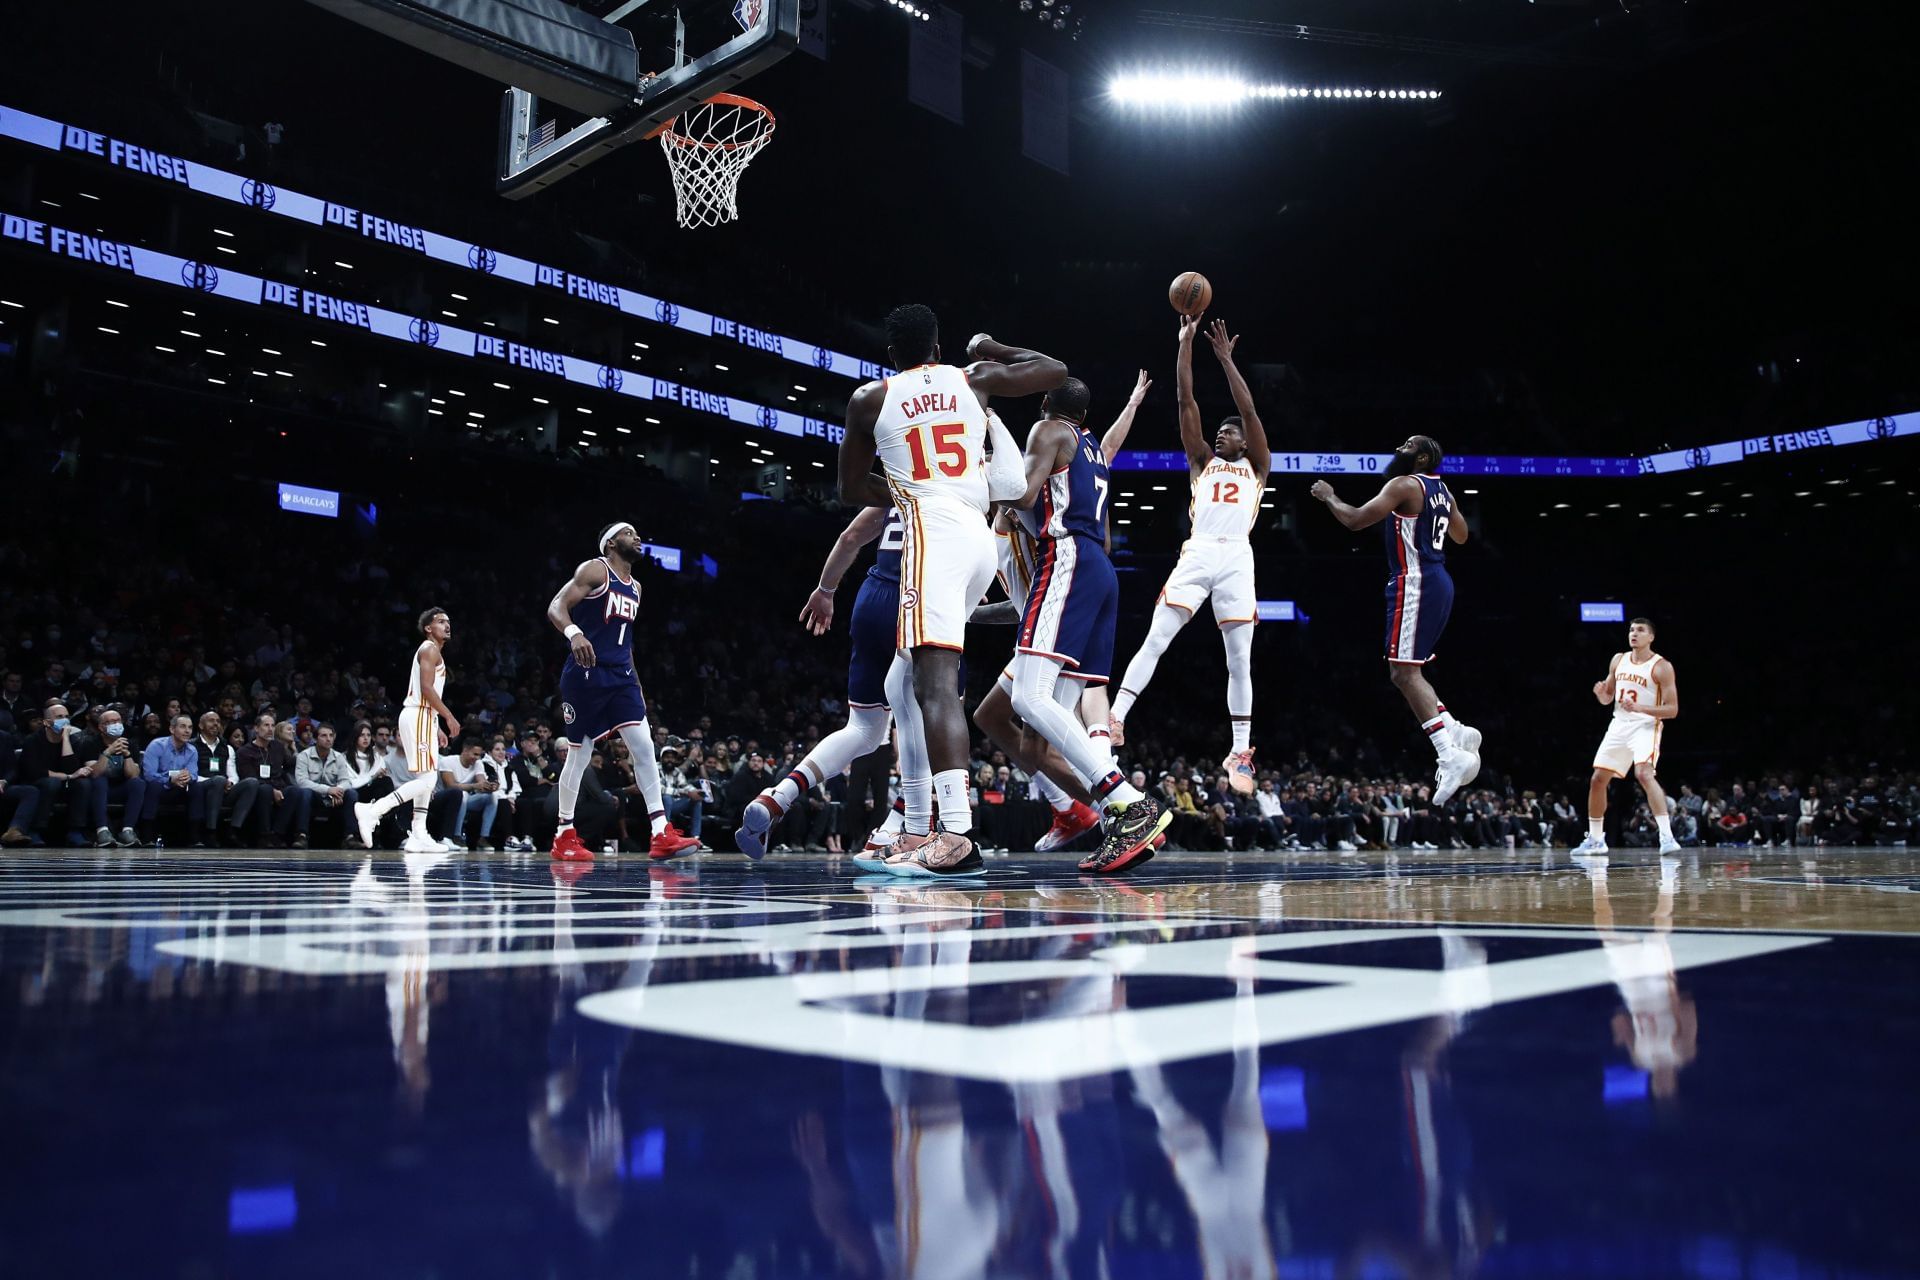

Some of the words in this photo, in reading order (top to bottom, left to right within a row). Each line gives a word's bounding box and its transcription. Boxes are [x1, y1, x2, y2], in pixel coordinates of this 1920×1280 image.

[65, 125, 107, 156] DE
[110, 138, 188, 184] FENSE
[2, 214, 47, 244] DE
[51, 226, 133, 271] FENSE
[326, 204, 360, 229] DE
[362, 213, 425, 251] FENSE
[538, 264, 566, 288] DE
[567, 274, 619, 307] FENSE
[265, 280, 300, 307] DE
[303, 289, 371, 329] FENSE
[713, 317, 737, 338] DE
[738, 325, 783, 355] FENSE
[477, 335, 506, 358] DE
[508, 342, 565, 376] FENSE
[862, 361, 881, 379] DE
[654, 380, 679, 401] DE
[681, 387, 729, 416] FENSE
[901, 393, 957, 419] CAPELA
[805, 417, 826, 437] DE
[1745, 436, 1771, 455] DE
[1773, 428, 1831, 453] FENSE
[904, 423, 969, 482] 15
[1204, 461, 1251, 479] ATLANTA
[1284, 456, 1300, 469] 11
[1316, 455, 1341, 465] 7:49
[1357, 457, 1377, 471] 10
[292, 493, 335, 510] BARCLAYS
[1094, 474, 1108, 521] 7
[1212, 482, 1239, 503] 12
[1432, 515, 1449, 551] 13
[618, 622, 627, 646] 1
[1618, 688, 1638, 704] 13
